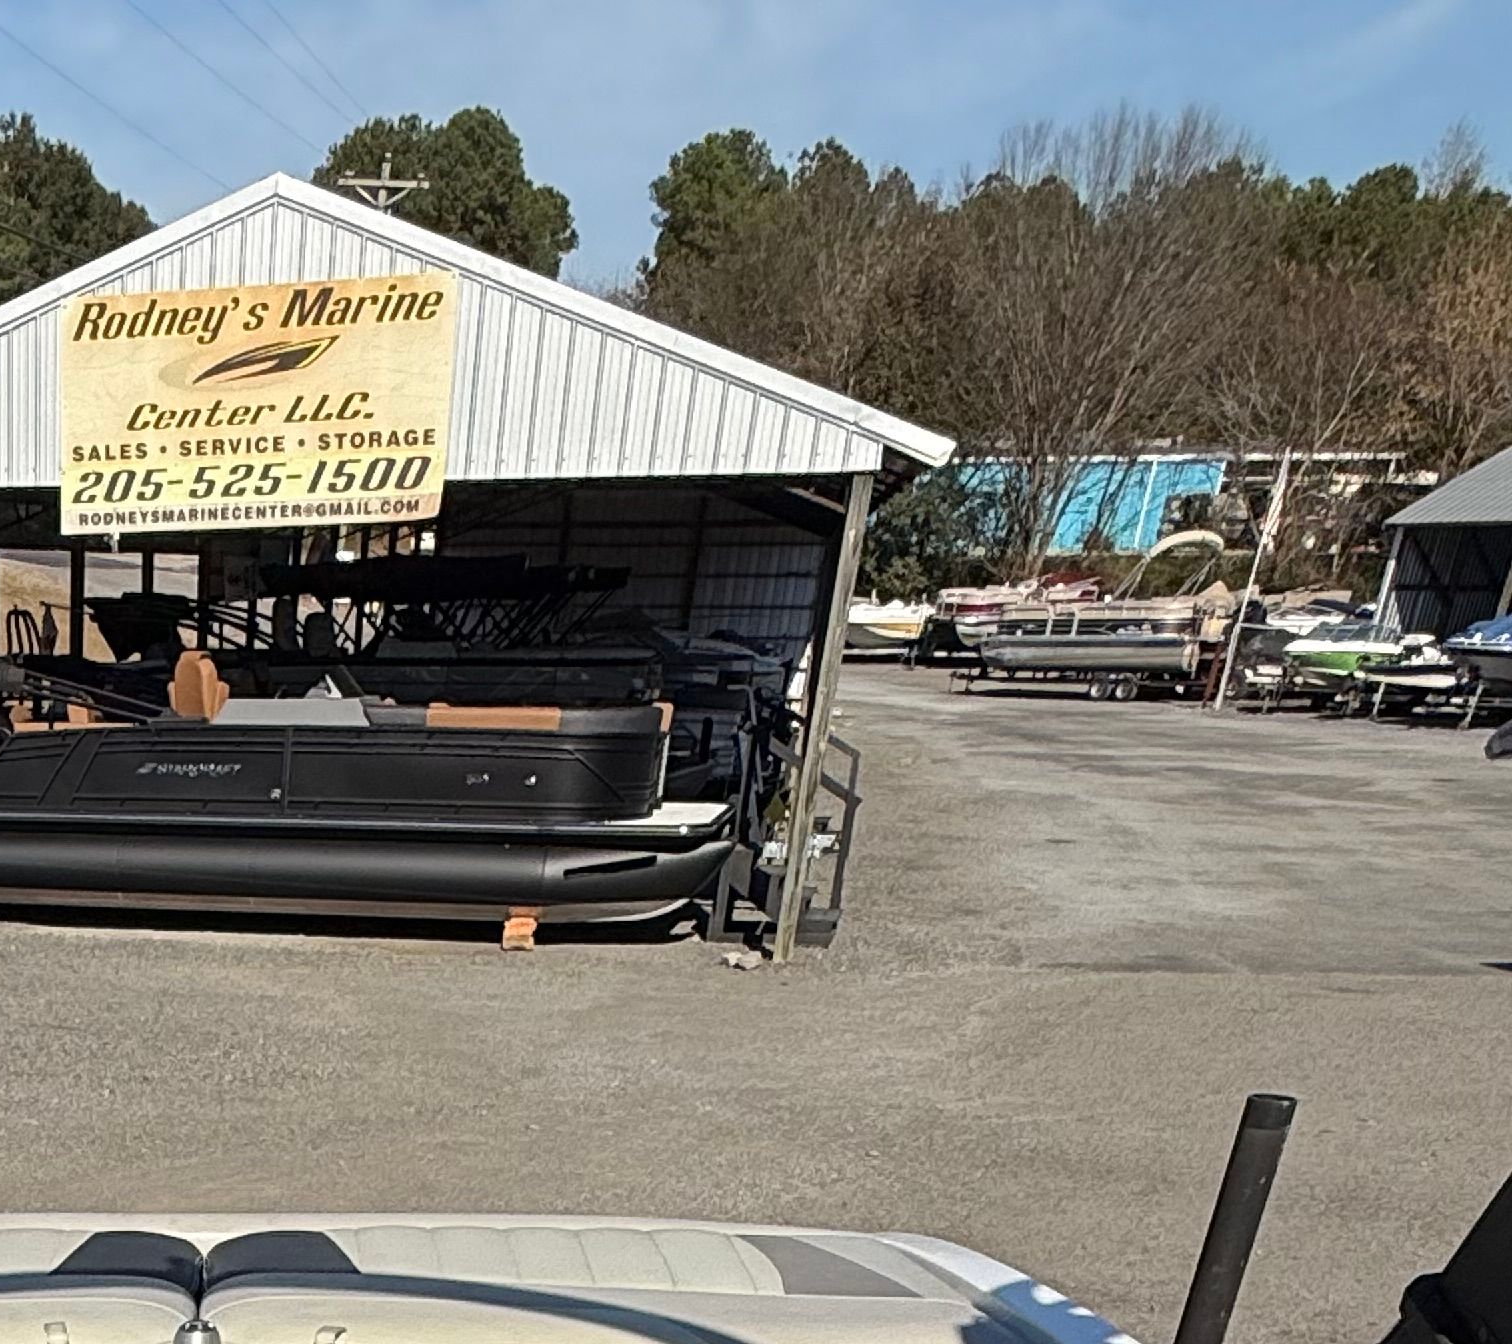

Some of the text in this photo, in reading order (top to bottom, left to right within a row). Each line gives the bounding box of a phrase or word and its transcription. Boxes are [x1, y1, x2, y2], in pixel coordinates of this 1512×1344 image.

[72, 284, 444, 345] Rodney's Marine
[126, 391, 375, 432] Center LLC.
[72, 428, 437, 463] SALES SERVICE STORAGE
[71, 456, 432, 505] 205-525-1500
[78, 498, 420, 527] RODNEYSMARINECENTER@GMAIL.COM
